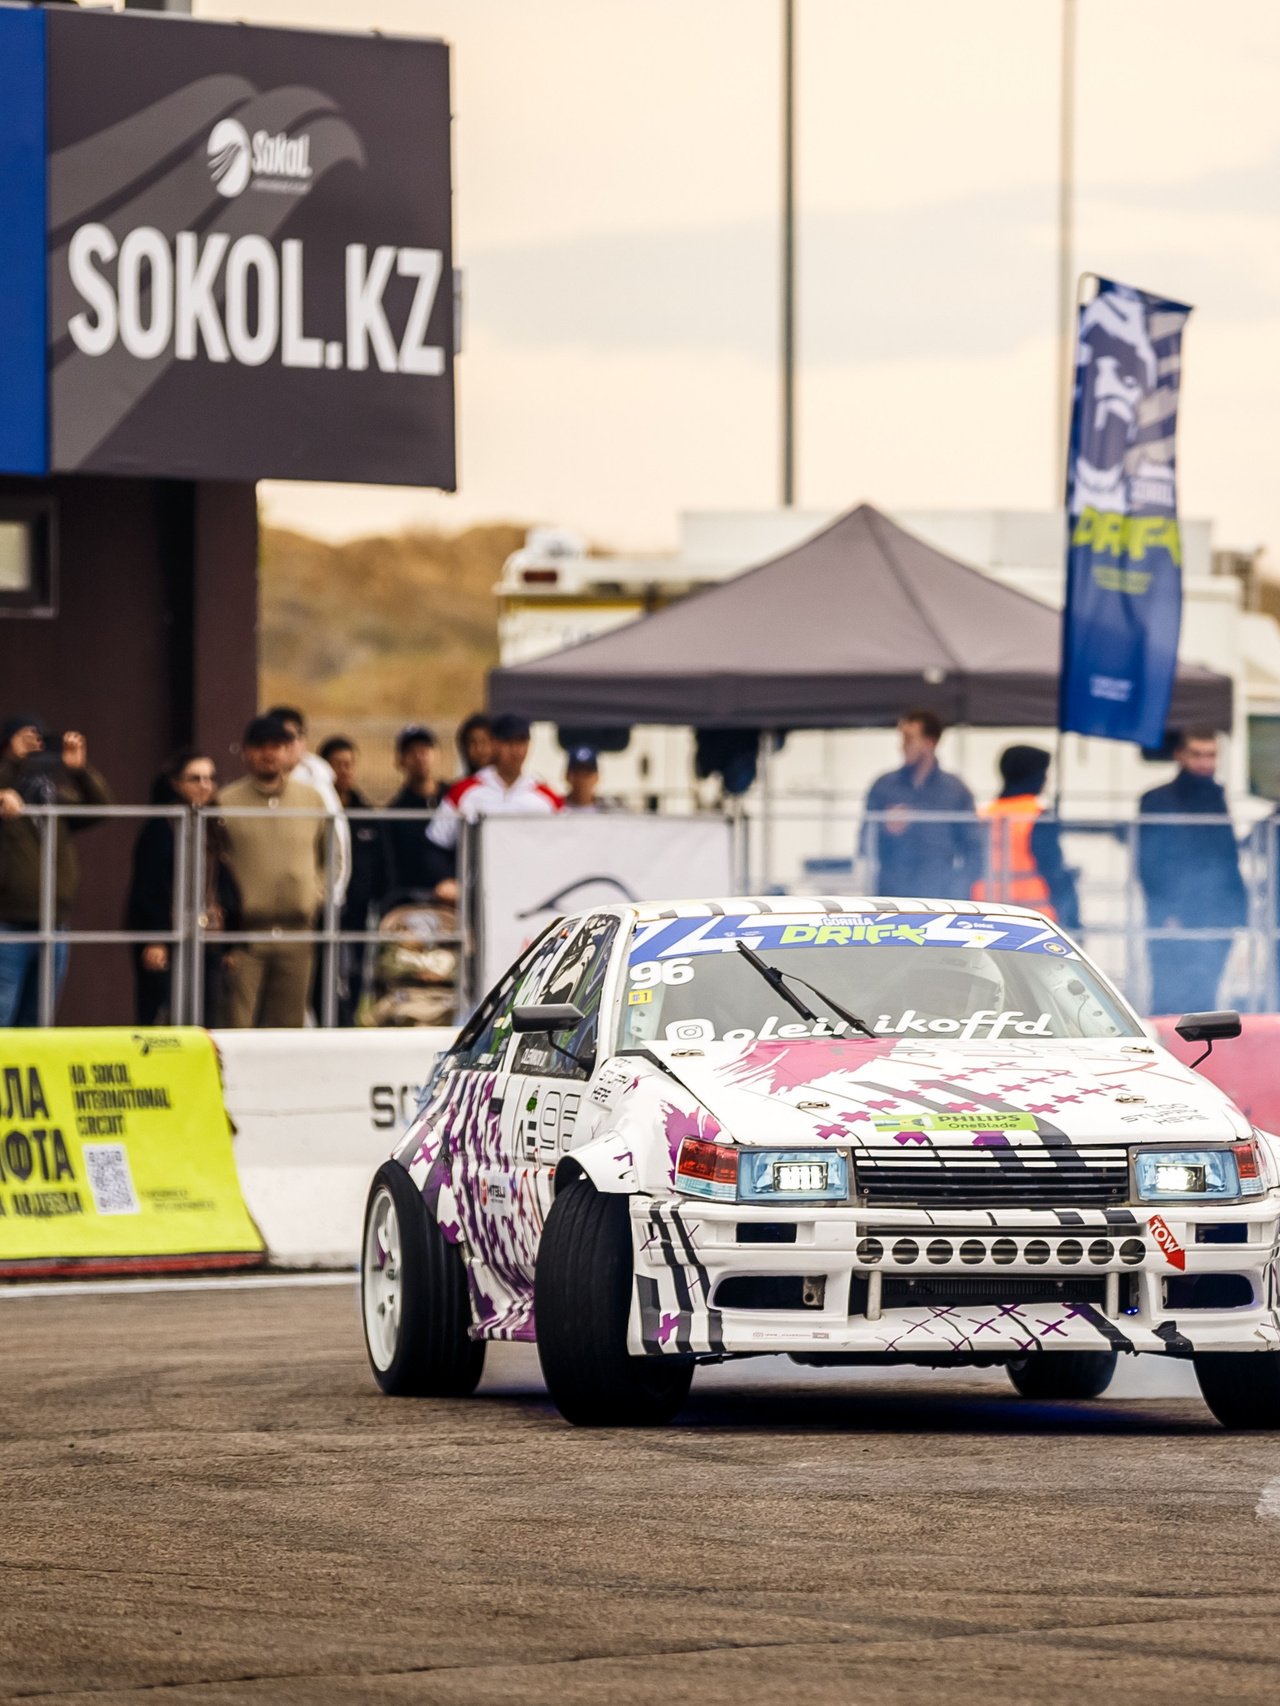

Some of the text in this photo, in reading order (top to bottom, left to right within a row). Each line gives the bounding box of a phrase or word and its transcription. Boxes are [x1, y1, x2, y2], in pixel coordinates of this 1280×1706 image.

[68, 222, 446, 376] SOKOL.KZ
[821, 917, 874, 926] GORILLA
[629, 957, 695, 990] 96
[937, 1114, 1021, 1123] PHILIPS
[1150, 1219, 1181, 1253] TOW
